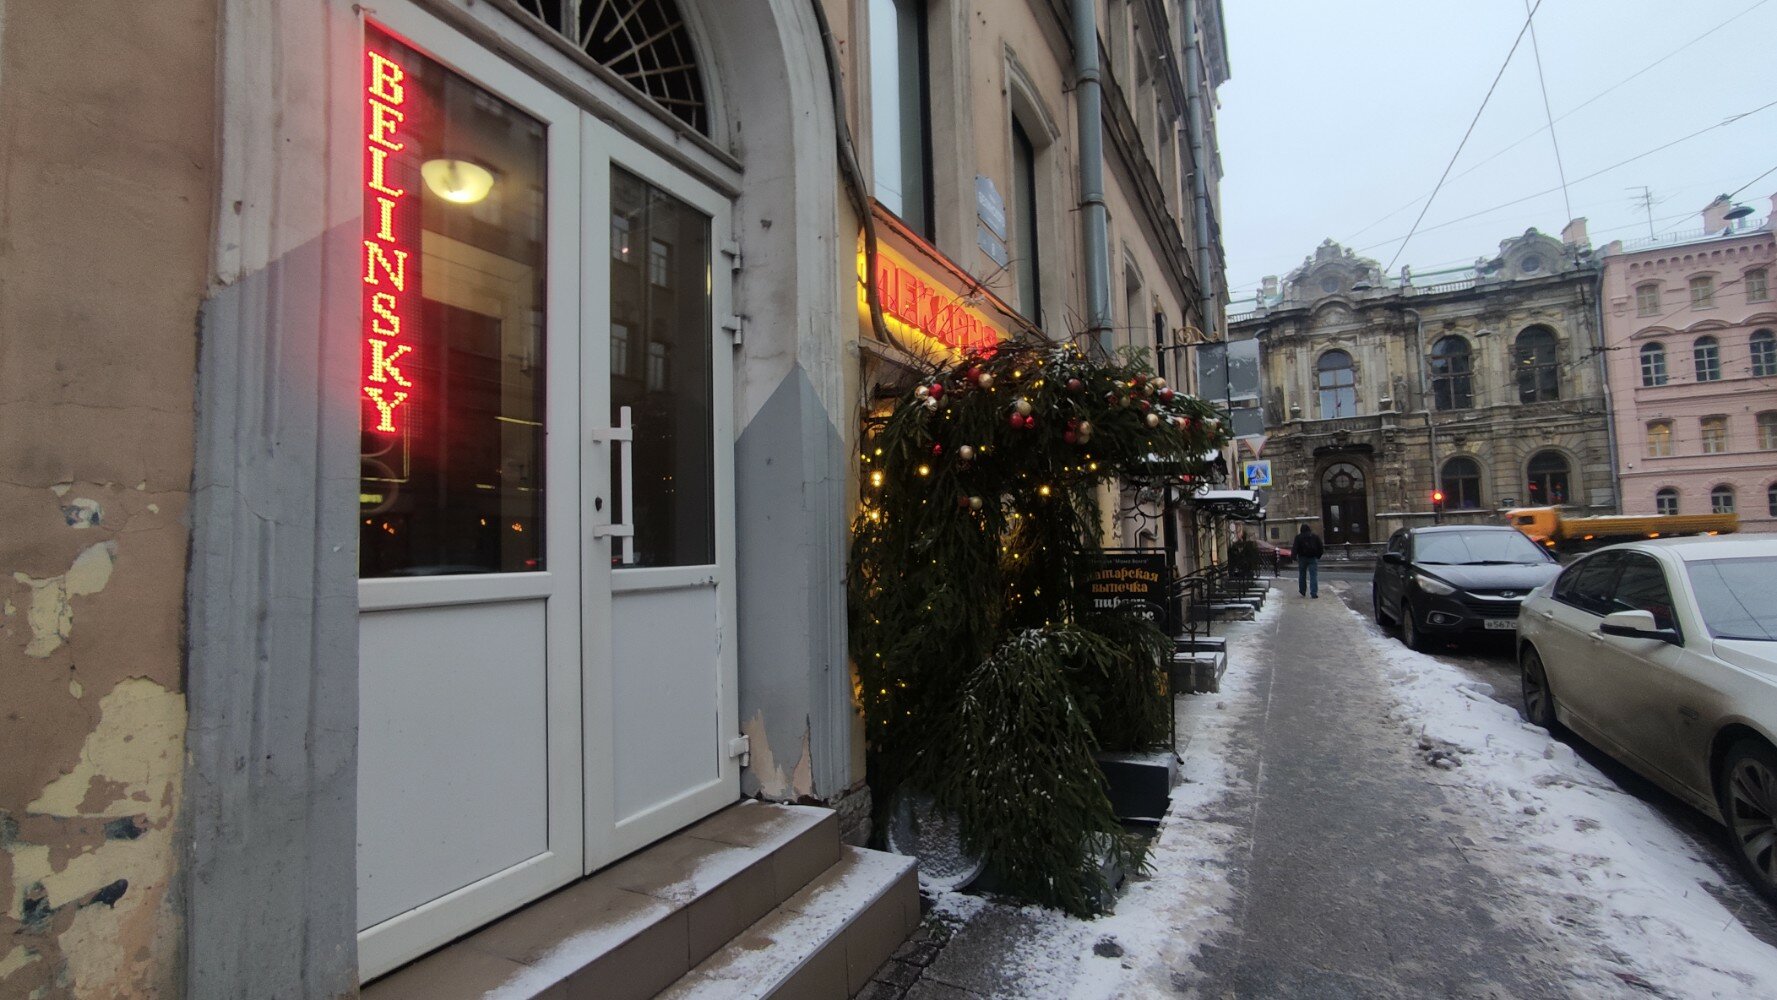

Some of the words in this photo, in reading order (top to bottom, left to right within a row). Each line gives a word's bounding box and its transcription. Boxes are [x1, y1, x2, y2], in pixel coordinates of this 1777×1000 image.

[364, 50, 412, 433] BELINSKY
[1090, 566, 1159, 582] атарская
[1091, 581, 1148, 592] выпечка
